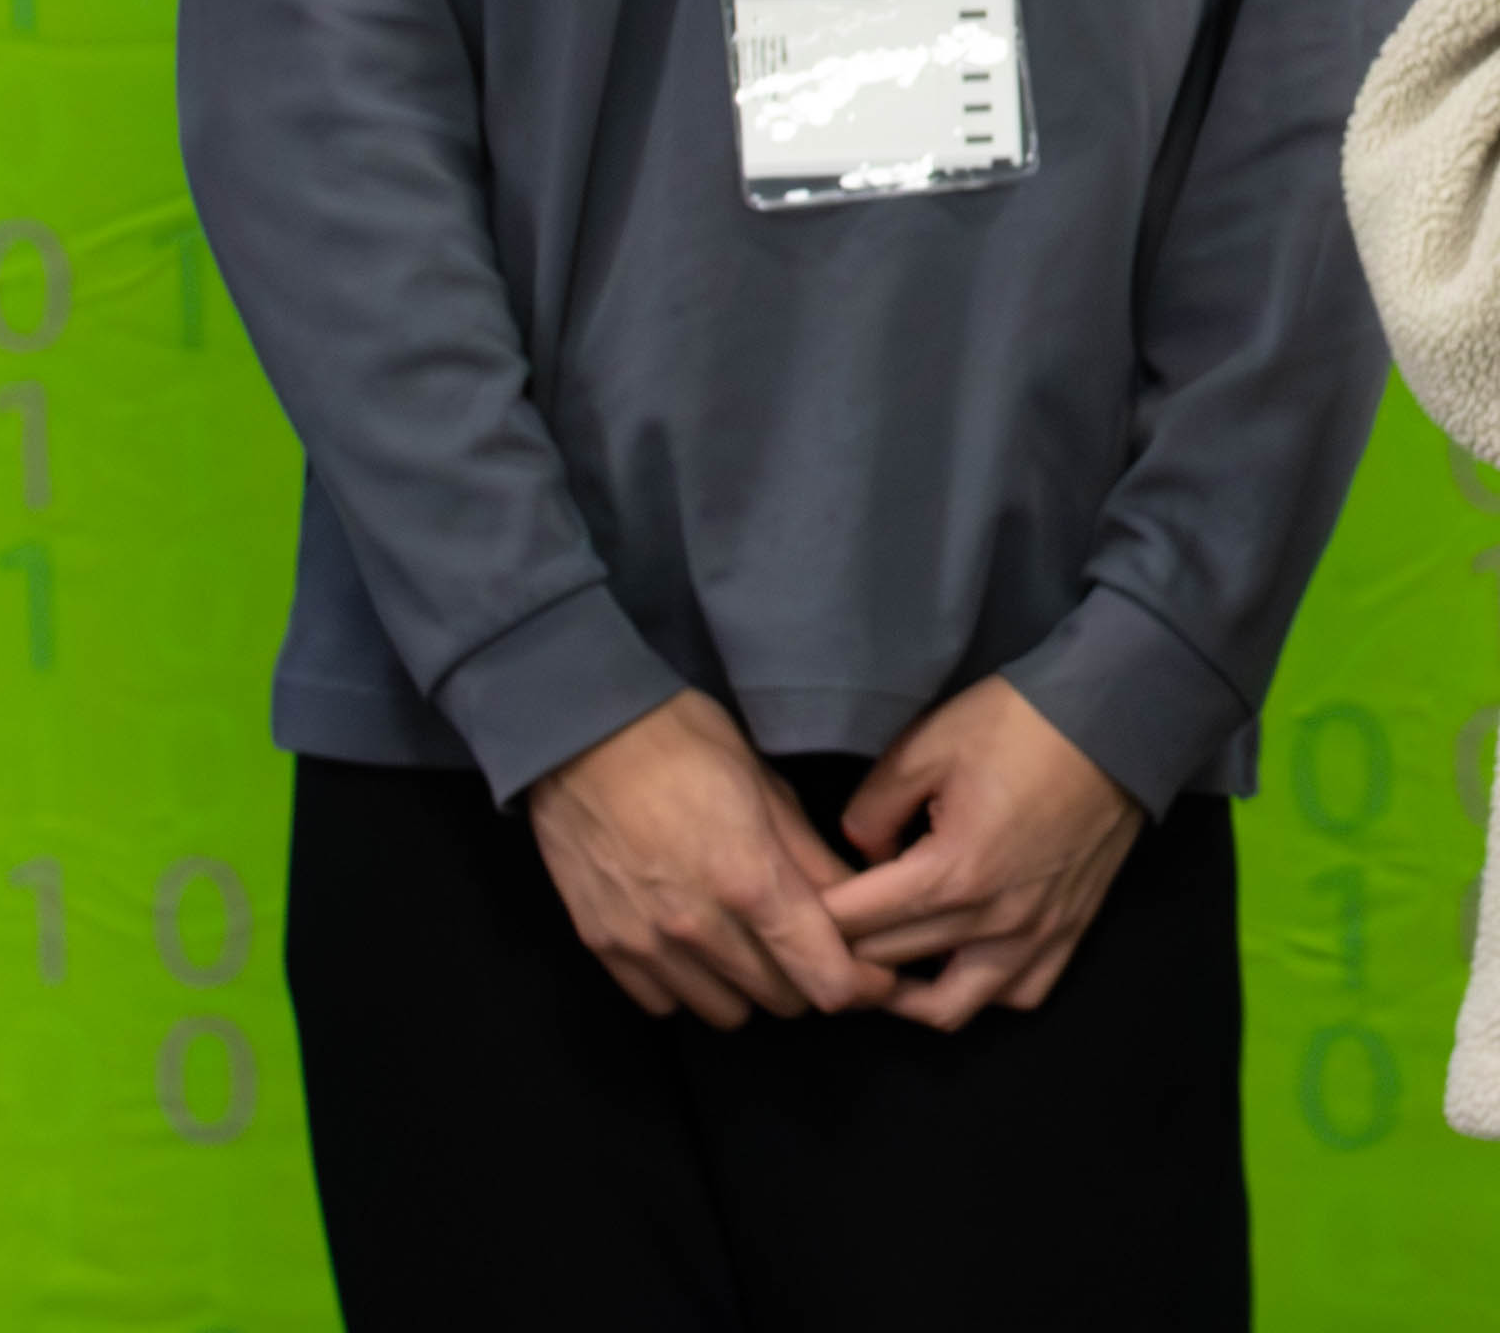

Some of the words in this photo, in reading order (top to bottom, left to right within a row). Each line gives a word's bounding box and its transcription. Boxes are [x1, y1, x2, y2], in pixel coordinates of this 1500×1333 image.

[152, 229, 204, 354] 1
[1295, 700, 1395, 838] 0
[7, 855, 66, 986] 1
[152, 853, 255, 990] 0
[1308, 864, 1367, 990] 1
[154, 1013, 259, 1147] 0
[1300, 1020, 1403, 1152] 0
